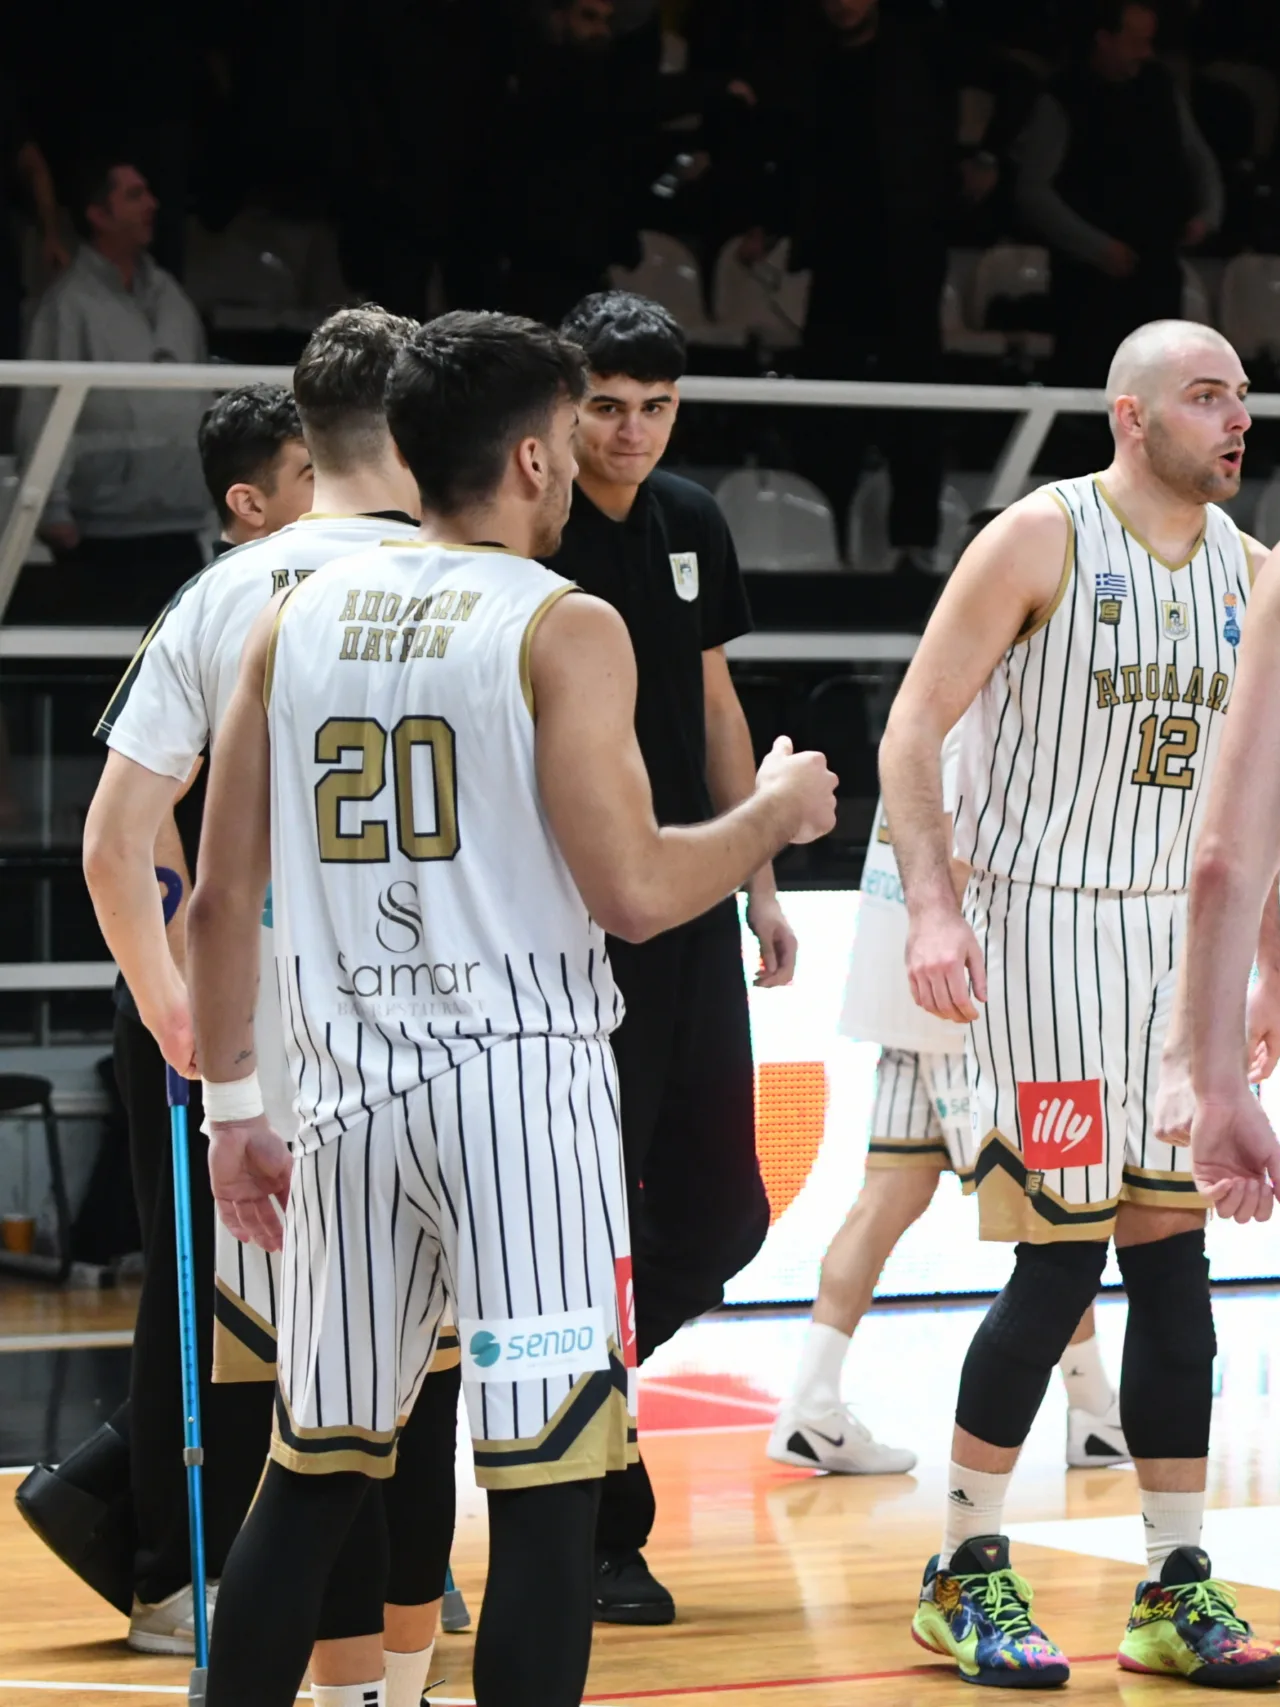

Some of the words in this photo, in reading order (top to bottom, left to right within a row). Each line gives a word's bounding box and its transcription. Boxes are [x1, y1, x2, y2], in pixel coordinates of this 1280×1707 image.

[1093, 662, 1229, 715] ΑΠΟΛΛΩ
[1130, 714, 1200, 790] 12
[314, 714, 461, 863] 20
[1032, 1097, 1093, 1153] illy
